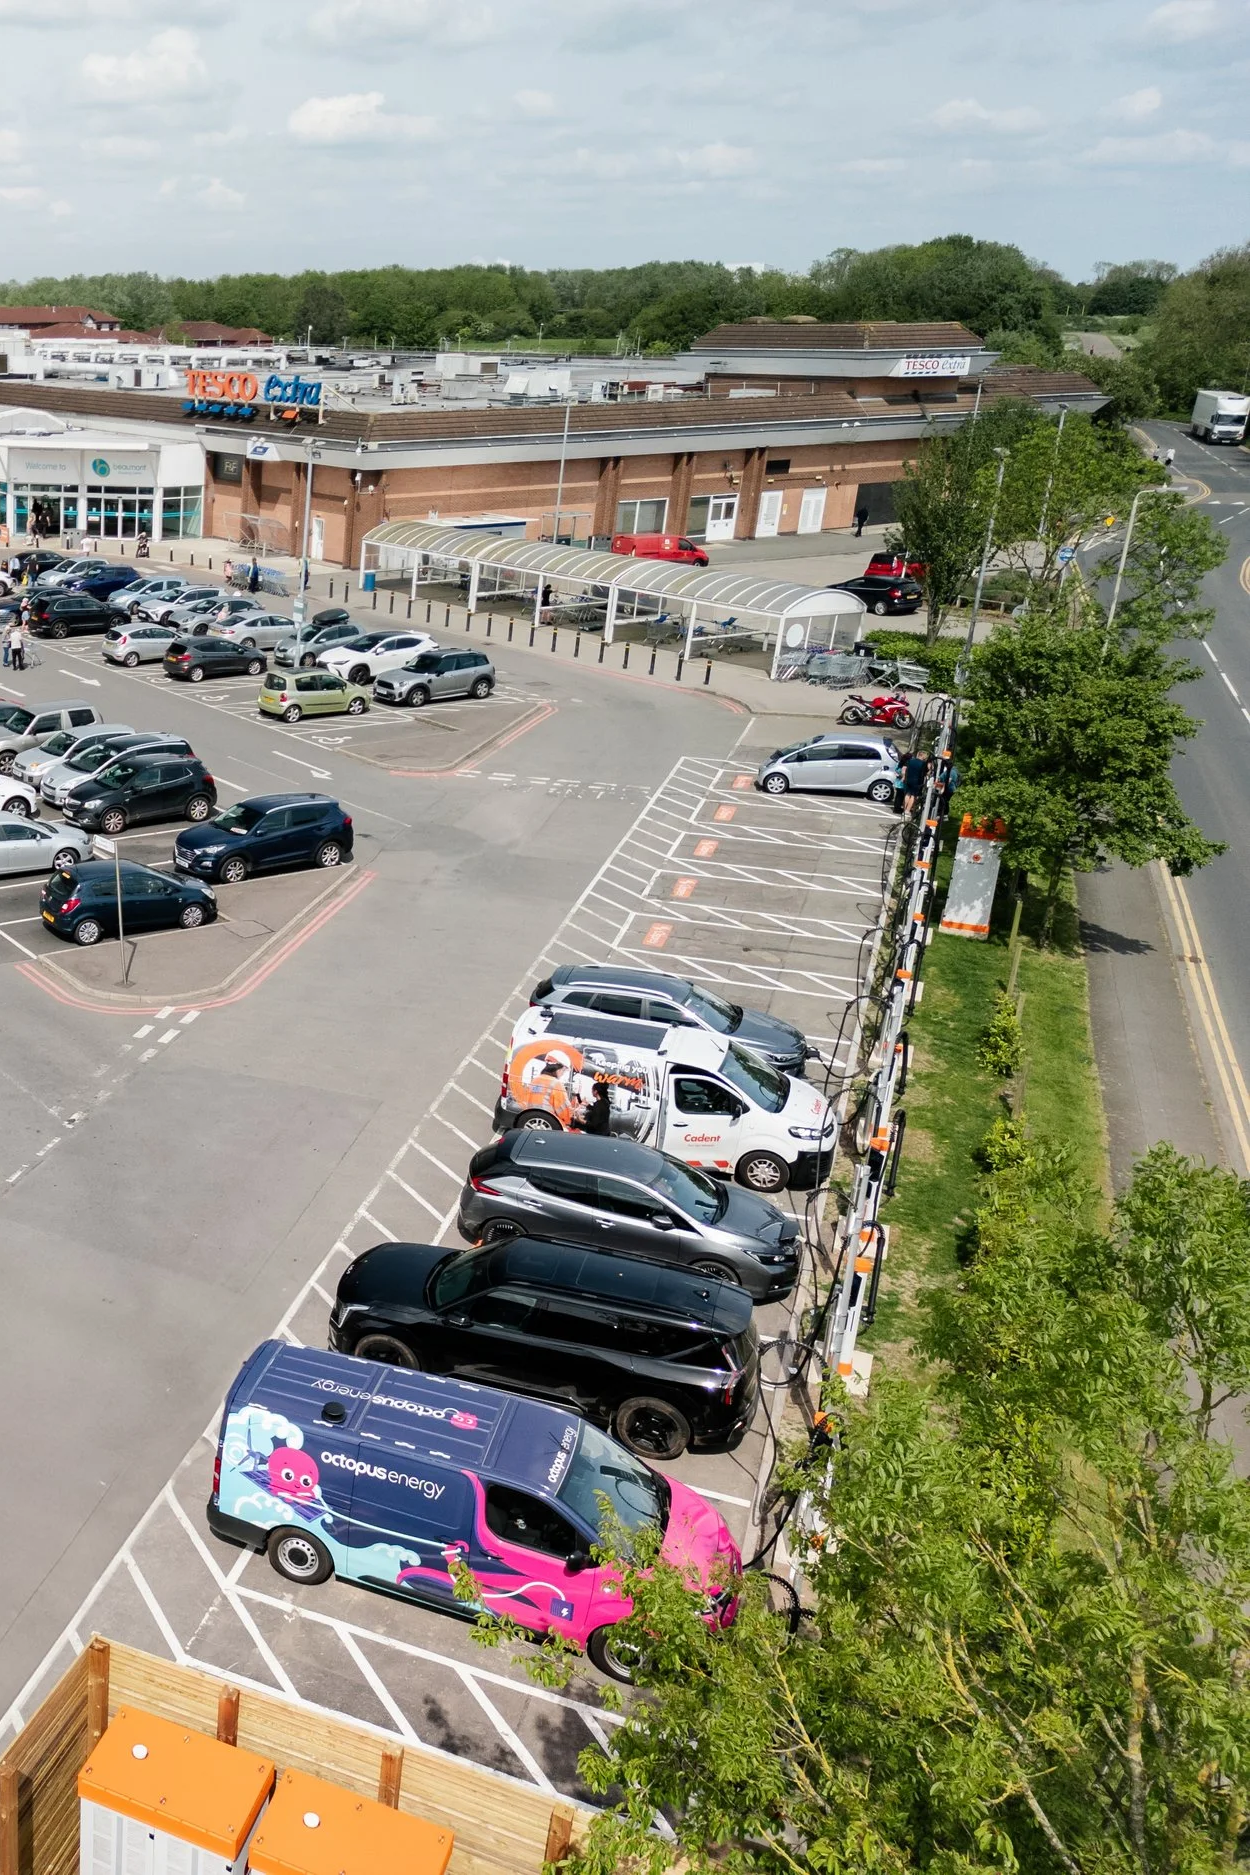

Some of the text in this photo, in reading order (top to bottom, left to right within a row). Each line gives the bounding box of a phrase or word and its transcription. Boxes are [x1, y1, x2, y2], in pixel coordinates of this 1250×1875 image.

[906, 359, 966, 370] TESCO extra
[184, 369, 322, 405] TESCO extra
[25, 462, 66, 471] Welcome to
[684, 1133, 721, 1143] Cadent
[311, 1378, 446, 1419] octopus energy
[320, 1450, 446, 1501] octopus energy
